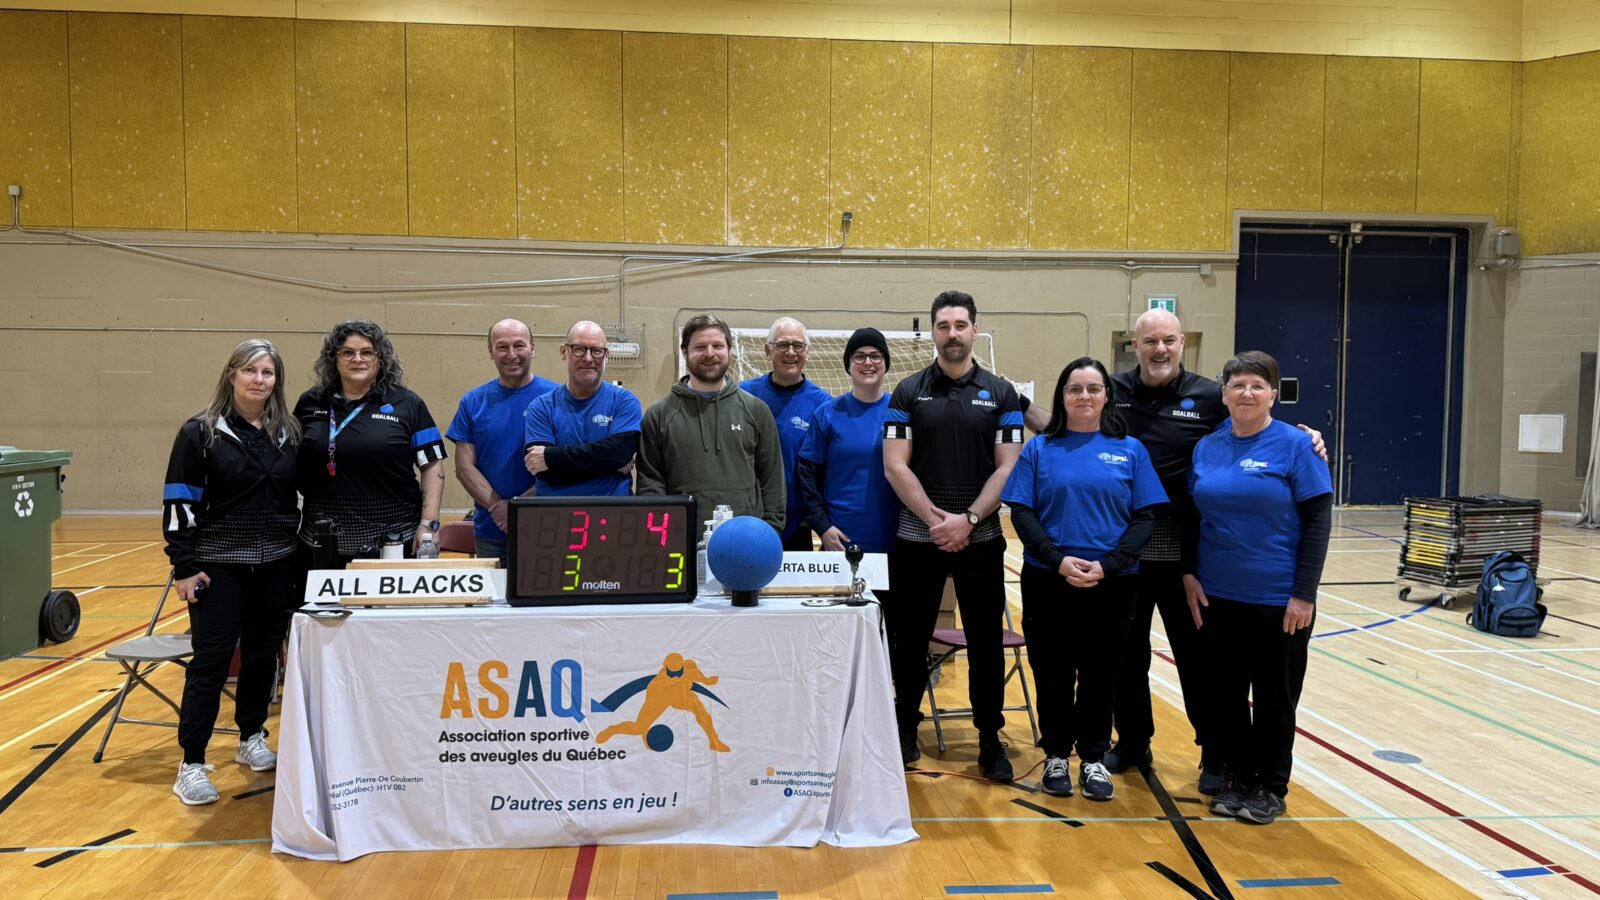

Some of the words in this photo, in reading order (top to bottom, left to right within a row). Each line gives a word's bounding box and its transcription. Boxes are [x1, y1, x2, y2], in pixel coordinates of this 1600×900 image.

[971, 399, 997, 407] GOALBALL
[1172, 410, 1200, 419] GOALBALL
[647, 512, 670, 546] 4
[562, 554, 582, 591] 3
[665, 552, 684, 589] 3
[779, 563, 805, 573] RTA
[808, 563, 840, 573] BLUE
[318, 577, 368, 597] ALL
[379, 574, 484, 594] BLACKS
[582, 580, 620, 590] molten
[440, 658, 586, 724] ASAQ
[438, 730, 526, 744] Association
[530, 728, 590, 744] sportive
[439, 750, 466, 763] des
[470, 749, 538, 765] aveugles
[542, 749, 562, 762] du
[566, 747, 627, 761] Québec
[331, 780, 354, 790] avenue
[355, 775, 389, 784] Pierre-De
[390, 775, 424, 783] Coubertin
[342, 785, 374, 796] (Québec)
[376, 783, 393, 791] H1V
[490, 795, 563, 812] D'autres
[567, 798, 607, 812] sens
[612, 797, 635, 809] en
[637, 793, 667, 813] jeu
